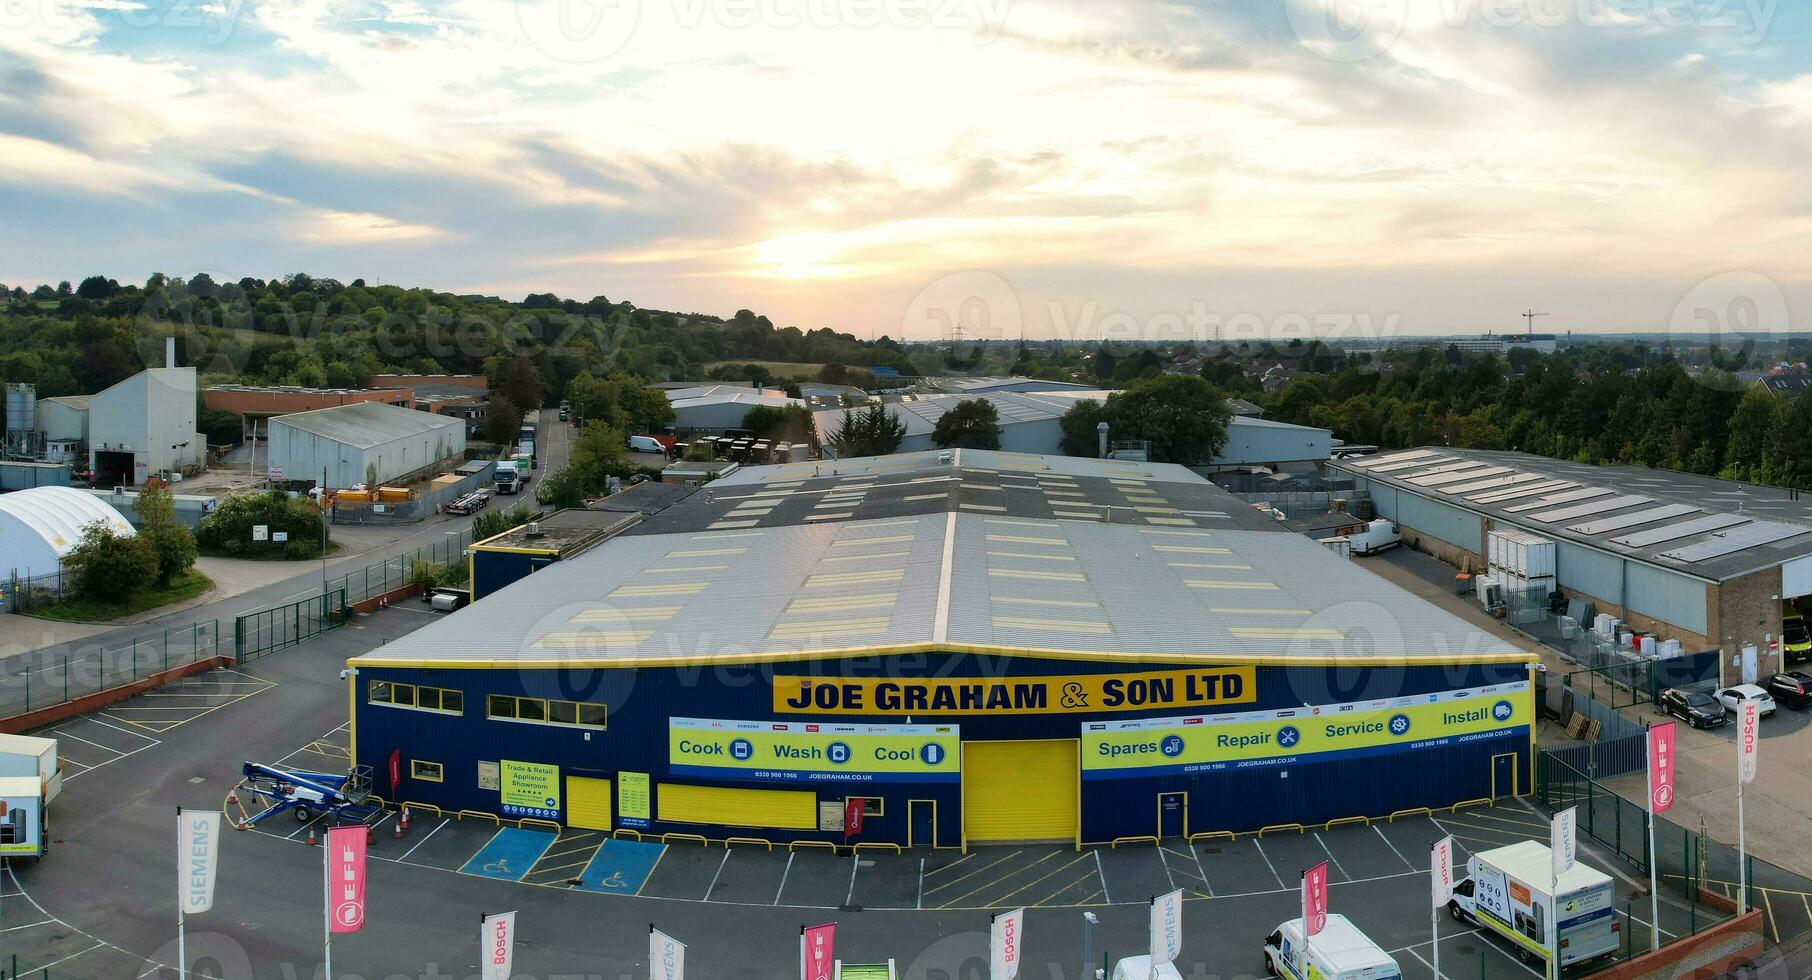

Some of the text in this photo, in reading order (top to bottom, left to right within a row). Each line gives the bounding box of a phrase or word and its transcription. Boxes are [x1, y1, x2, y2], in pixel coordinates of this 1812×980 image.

[786, 673, 1243, 712] JOE GRAHAM & SON LTD
[1443, 707, 1488, 725] Install
[1325, 721, 1384, 738] Service
[1458, 729, 1513, 742] JOEGRAHAM.CO.UK
[1743, 705, 1755, 754] BOSCH
[679, 740, 724, 755] Cook
[1217, 731, 1272, 749] Repair
[773, 745, 822, 759] Wash
[874, 747, 915, 761] Cool
[1098, 742, 1158, 758] Spares
[533, 767, 553, 775] Retail
[1236, 756, 1297, 768] JOEGRAHAM.CO.UK
[512, 780, 548, 790] Showroom
[513, 772, 546, 782] Appliance
[1561, 813, 1573, 870] SIEMENS
[190, 819, 209, 907] SIEMENS
[1439, 844, 1449, 885] BOSCH
[341, 845, 359, 925] NEFF
[1585, 893, 1602, 901] GRAHAM
[1167, 896, 1175, 960] SIEMENS
[493, 920, 507, 965] BOSCH
[1004, 917, 1014, 963] BOSCH
[664, 939, 675, 980] MENS
